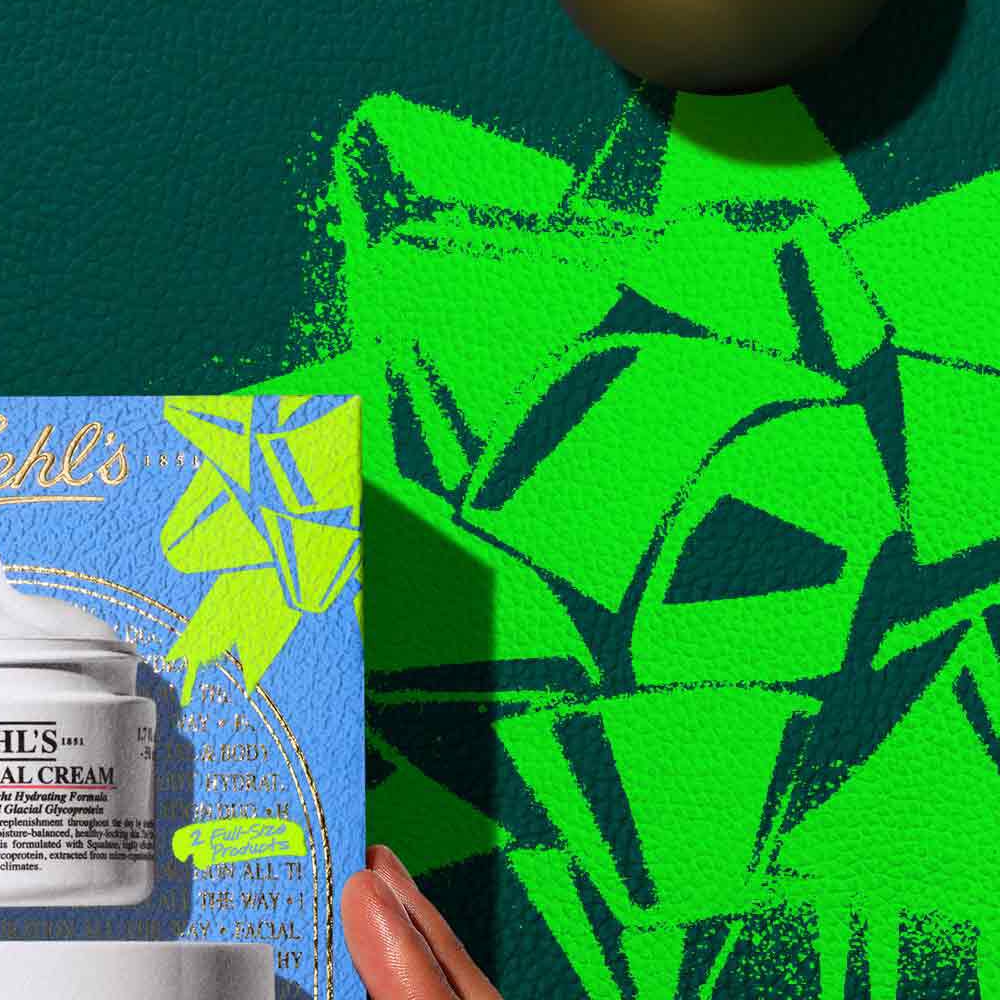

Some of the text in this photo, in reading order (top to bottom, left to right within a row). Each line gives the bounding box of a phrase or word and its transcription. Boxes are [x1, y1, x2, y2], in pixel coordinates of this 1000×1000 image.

[144, 454, 200, 468] 1851
[61, 737, 84, 746] 1851
[37, 766, 115, 785] CREAM
[14, 791, 67, 804] Hydrating
[69, 791, 108, 802] Formula
[4, 804, 42, 815] Glacial
[45, 804, 104, 817] Glycoprotein
[0, 818, 63, 829] replenishment
[0, 840, 8, 849] is
[12, 839, 62, 849] formulated
[65, 839, 84, 849] with
[190, 829, 205, 847] 2
[49, 850, 88, 860] extracted
[211, 837, 291, 862] Products
[0, 861, 43, 871] climates.
[244, 862, 280, 881] ALL
[241, 891, 281, 912] WAY
[232, 919, 302, 940] FACIAL
